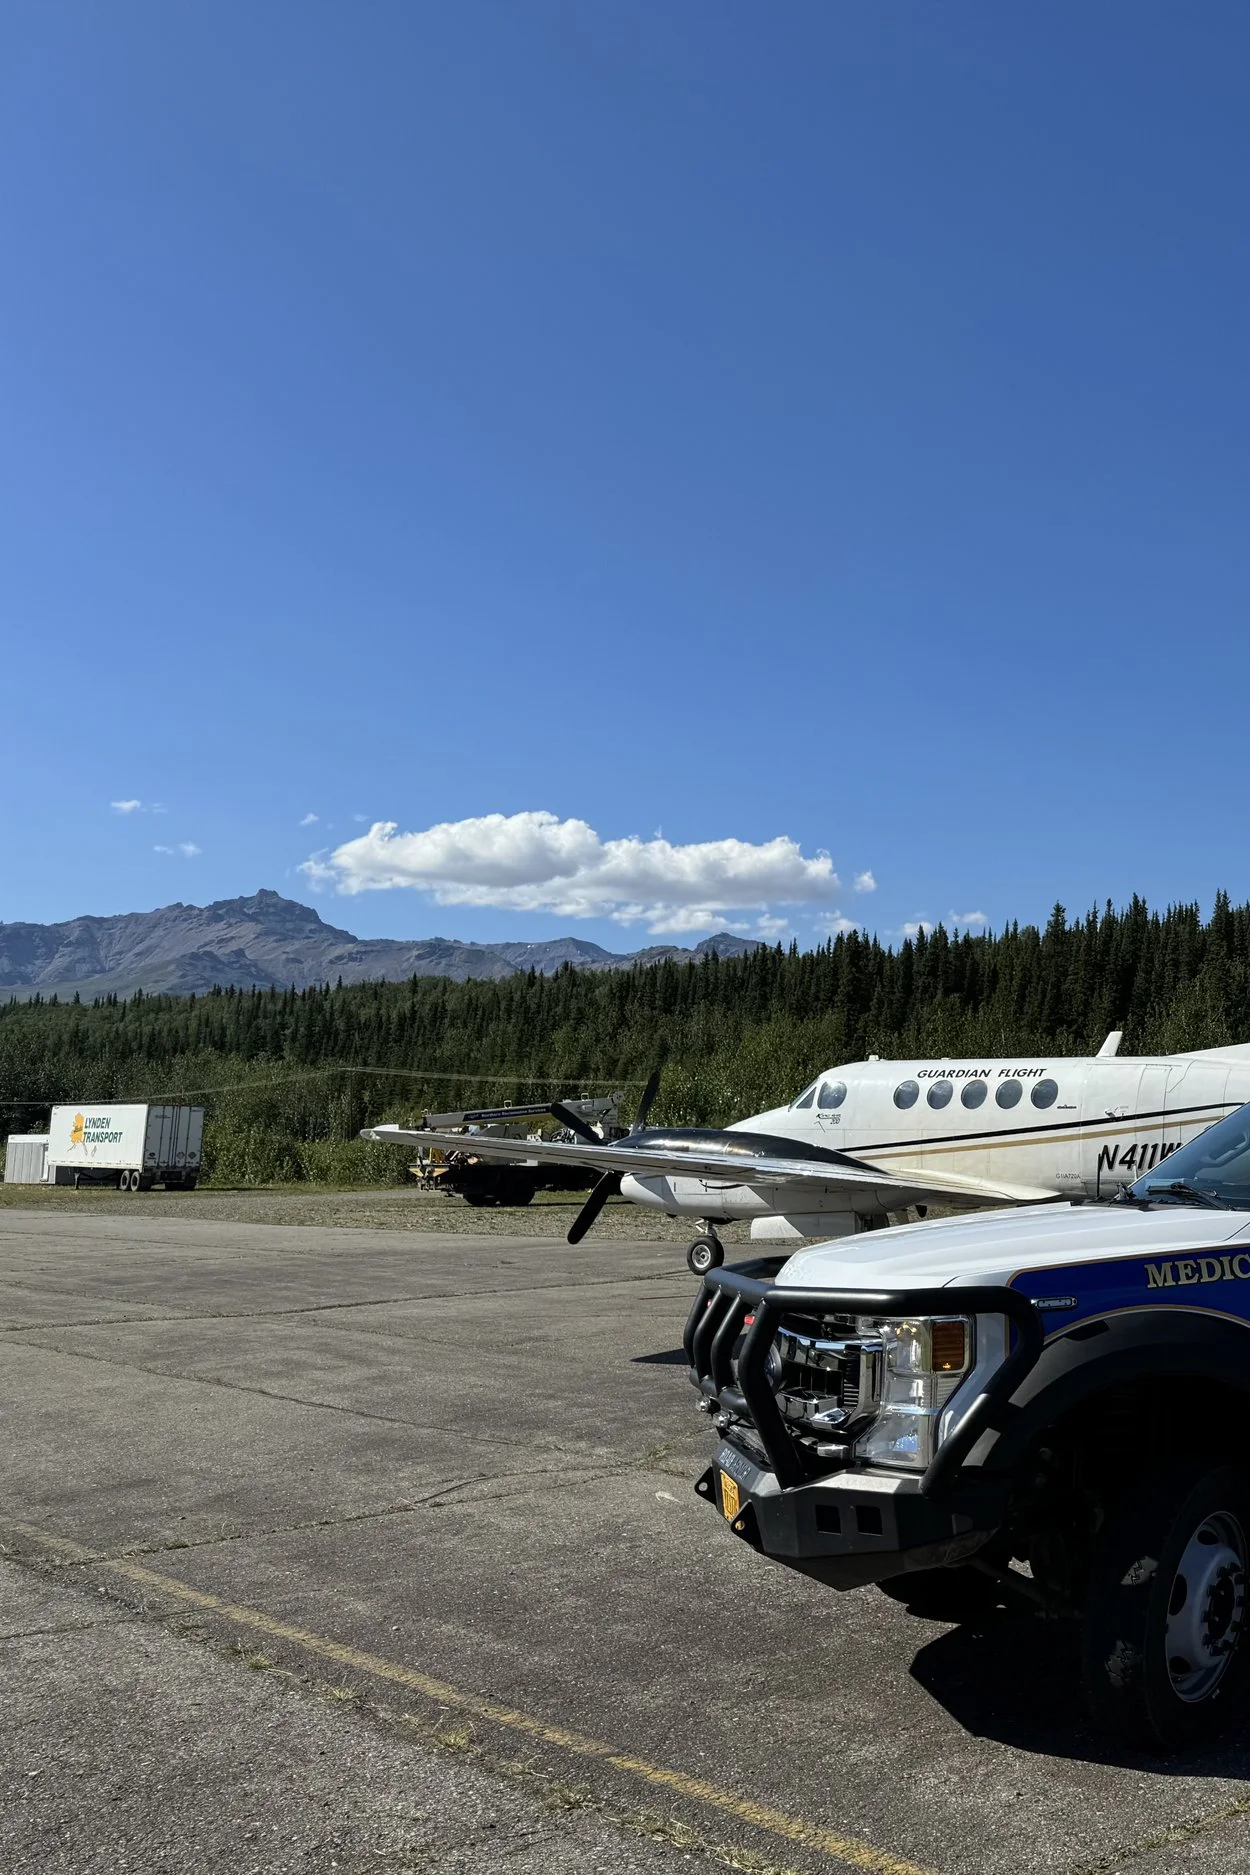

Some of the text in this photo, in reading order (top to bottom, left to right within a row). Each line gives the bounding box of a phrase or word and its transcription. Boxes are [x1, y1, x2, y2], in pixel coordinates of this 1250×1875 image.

[917, 1068, 1047, 1079] GUARDIAN FLIGHT
[85, 1117, 112, 1129] LYNDEN
[83, 1131, 123, 1143] TRANSPORT
